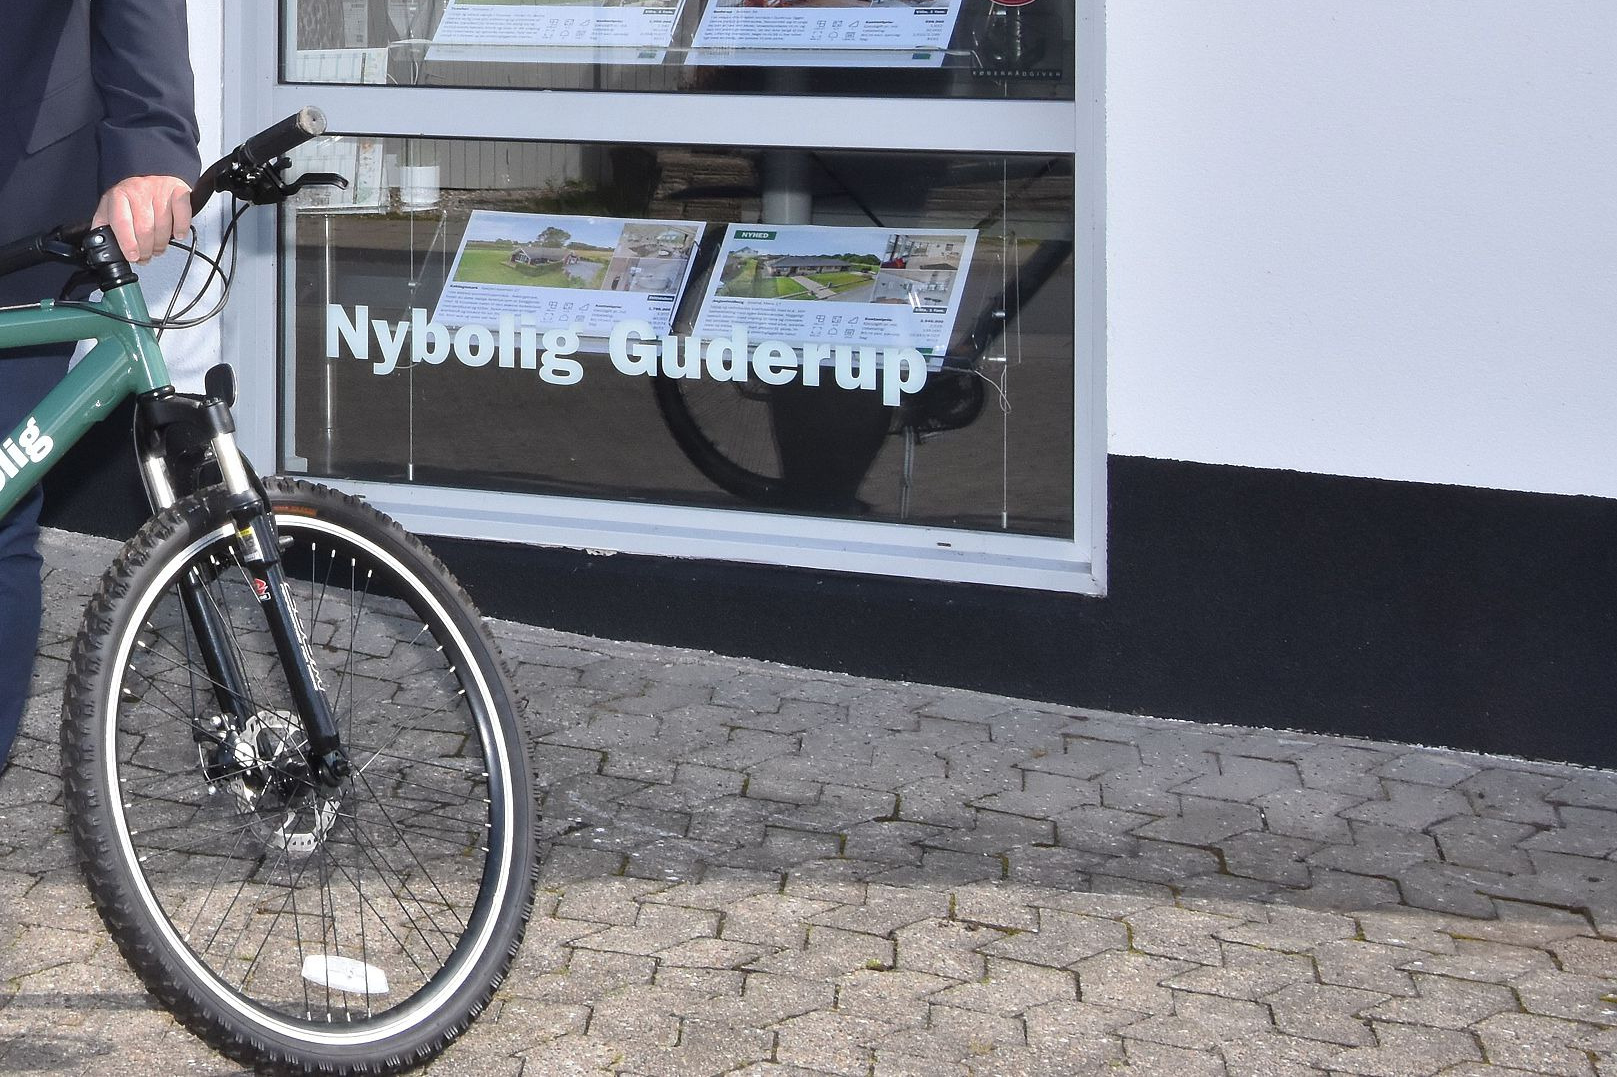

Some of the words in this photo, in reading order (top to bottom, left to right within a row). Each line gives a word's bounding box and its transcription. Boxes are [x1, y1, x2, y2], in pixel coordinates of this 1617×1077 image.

[740, 231, 770, 239] NYHED
[326, 303, 584, 384] Nybolig
[608, 322, 928, 407] Guderup
